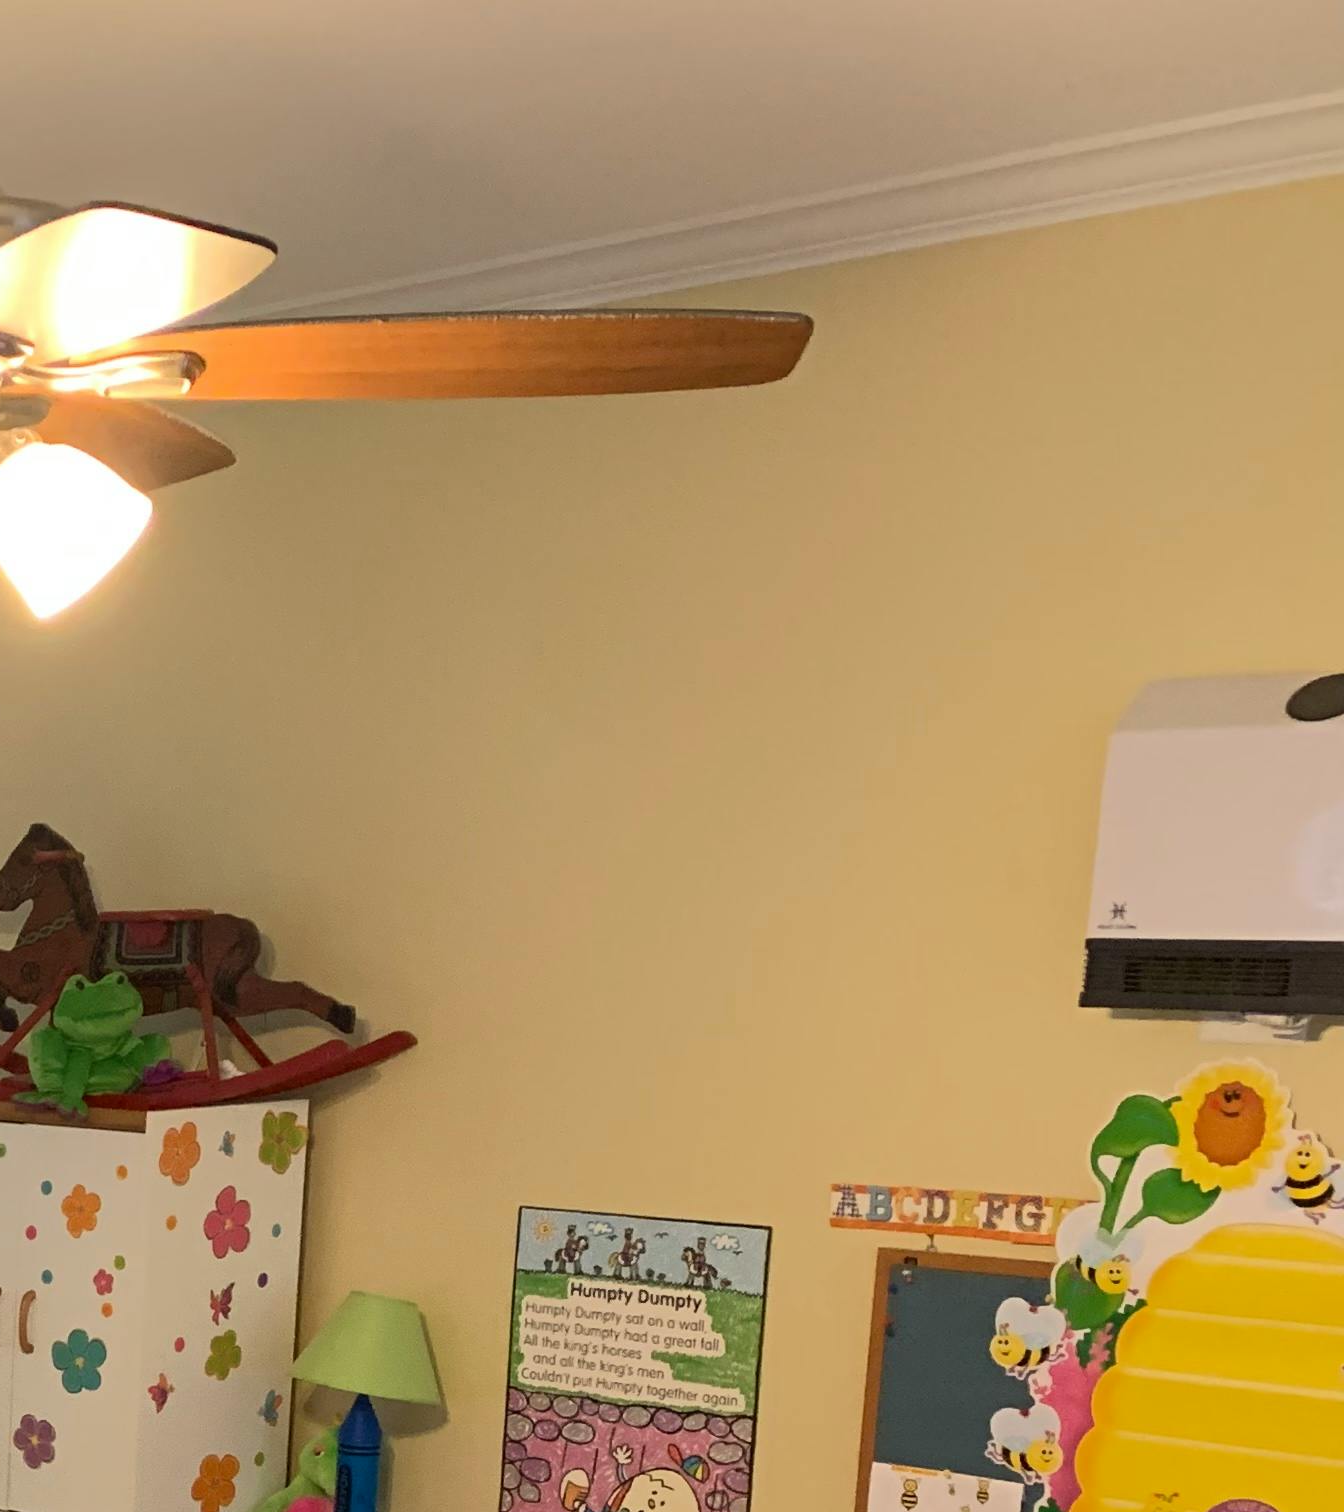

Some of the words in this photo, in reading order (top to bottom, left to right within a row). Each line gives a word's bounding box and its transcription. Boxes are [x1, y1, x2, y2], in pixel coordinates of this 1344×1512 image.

[570, 1282, 633, 1305] Humpty
[638, 1289, 702, 1313] Dumpty
[525, 1302, 571, 1319] Humpty
[575, 1306, 622, 1325] Dumpty
[625, 1314, 644, 1325] sat
[647, 1317, 663, 1328] on
[667, 1319, 675, 1329] a
[524, 1318, 570, 1336] Humpty
[574, 1323, 620, 1341] Dumpty
[624, 1328, 648, 1343] had
[651, 1334, 660, 1344] a
[664, 1336, 697, 1349] great
[700, 1337, 720, 1352] fall
[524, 1334, 538, 1346] All
[542, 1336, 560, 1349] the
[563, 1338, 598, 1356] king's
[601, 1344, 642, 1360] horses
[533, 1353, 557, 1366] and
[560, 1355, 574, 1368] all
[577, 1357, 596, 1371] the
[600, 1360, 634, 1377] king's
[636, 1367, 664, 1379] men
[521, 1367, 570, 1384] Couldn't
[572, 1375, 593, 1388] put
[596, 1377, 643, 1396] Humpty
[647, 1385, 698, 1401] together
